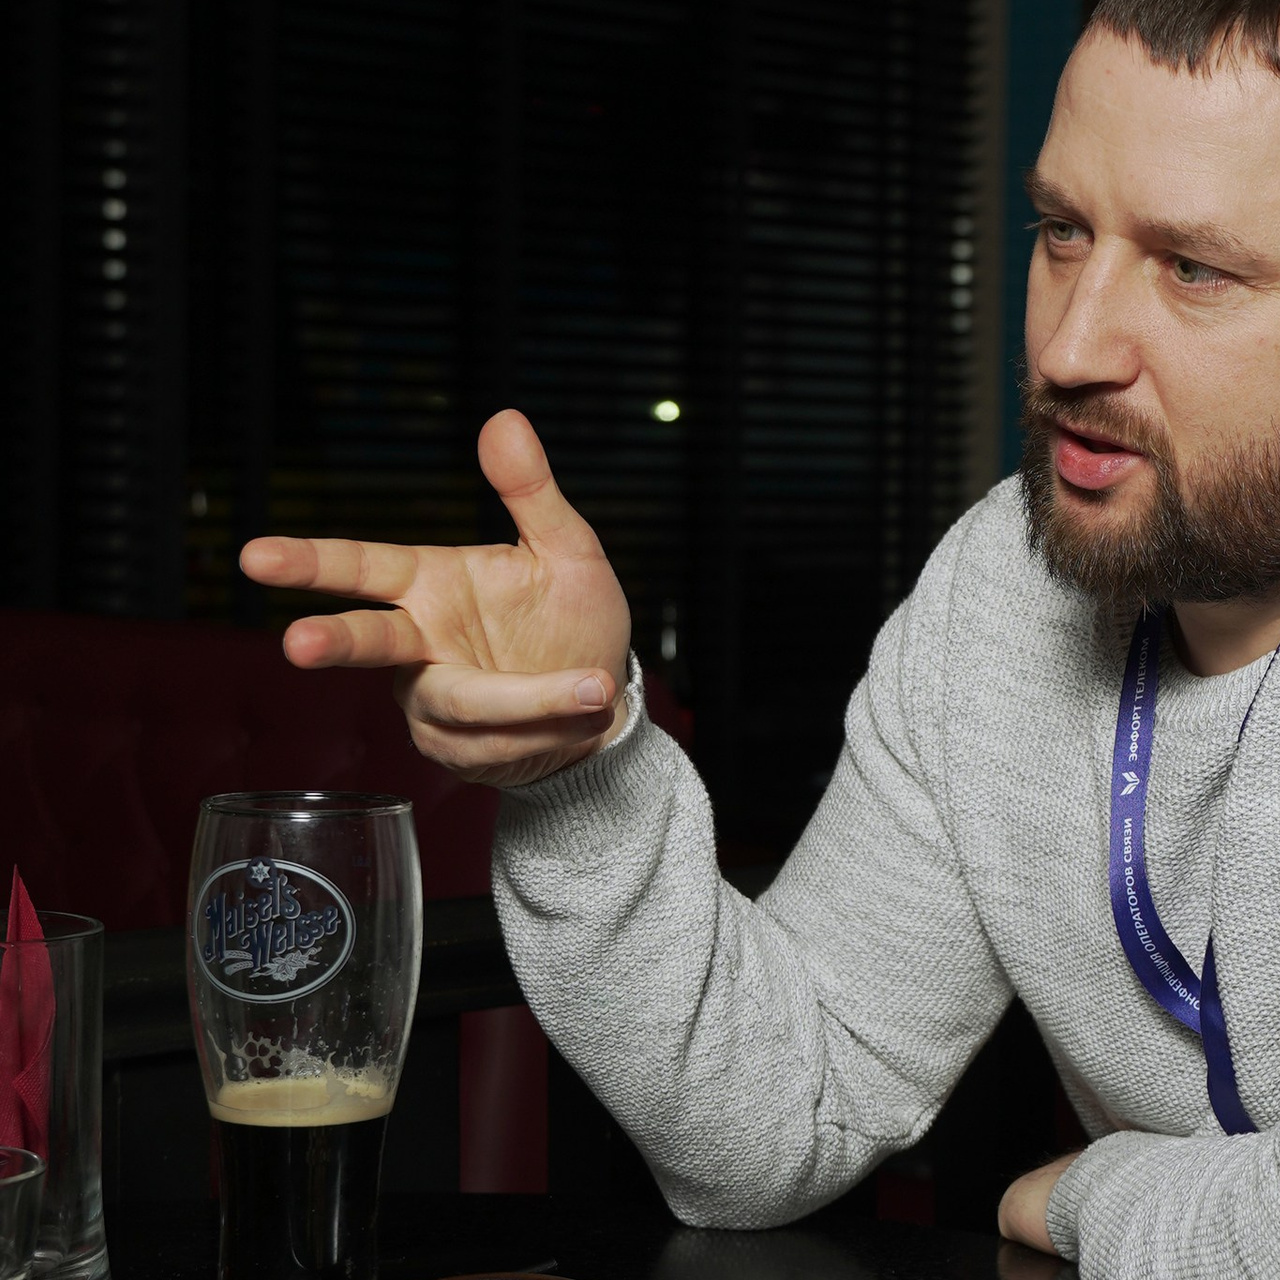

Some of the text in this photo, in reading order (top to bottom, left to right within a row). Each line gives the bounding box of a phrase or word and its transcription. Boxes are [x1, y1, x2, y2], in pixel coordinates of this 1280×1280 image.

[1128, 636, 1150, 762] ЭФФОРТ ТЕЛЕКОМ
[239, 906, 342, 972] Weisse
[1123, 817, 1200, 1011] ОНФЕРЕНЦИЯ ОПЕРАТОРОВ СВЯЗИ
